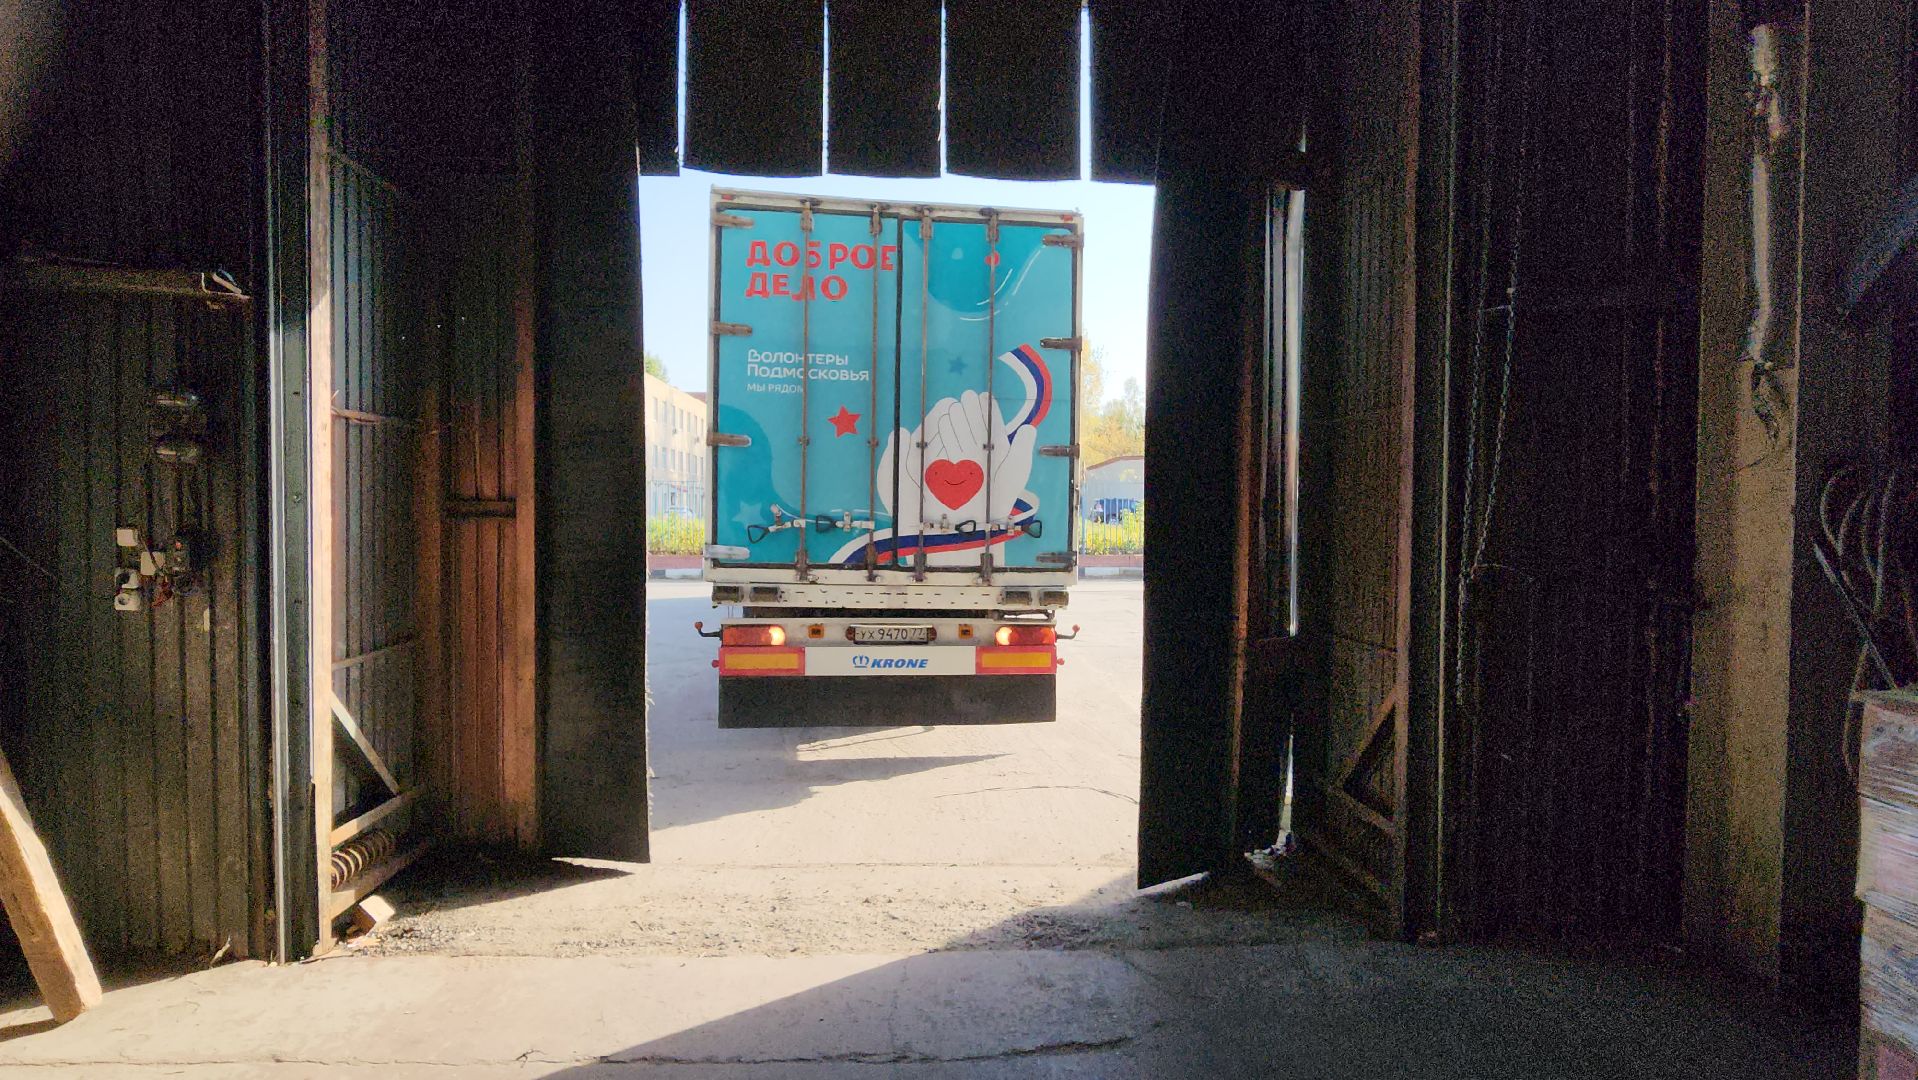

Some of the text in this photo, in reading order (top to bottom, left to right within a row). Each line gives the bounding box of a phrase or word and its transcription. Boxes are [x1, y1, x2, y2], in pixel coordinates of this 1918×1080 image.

[745, 240, 897, 271] ДОБРОЕ
[745, 272, 848, 301] ДЕЛО
[746, 383, 766, 392] МЫ
[877, 628, 908, 640] 9470
[871, 658, 929, 669] KRONE
